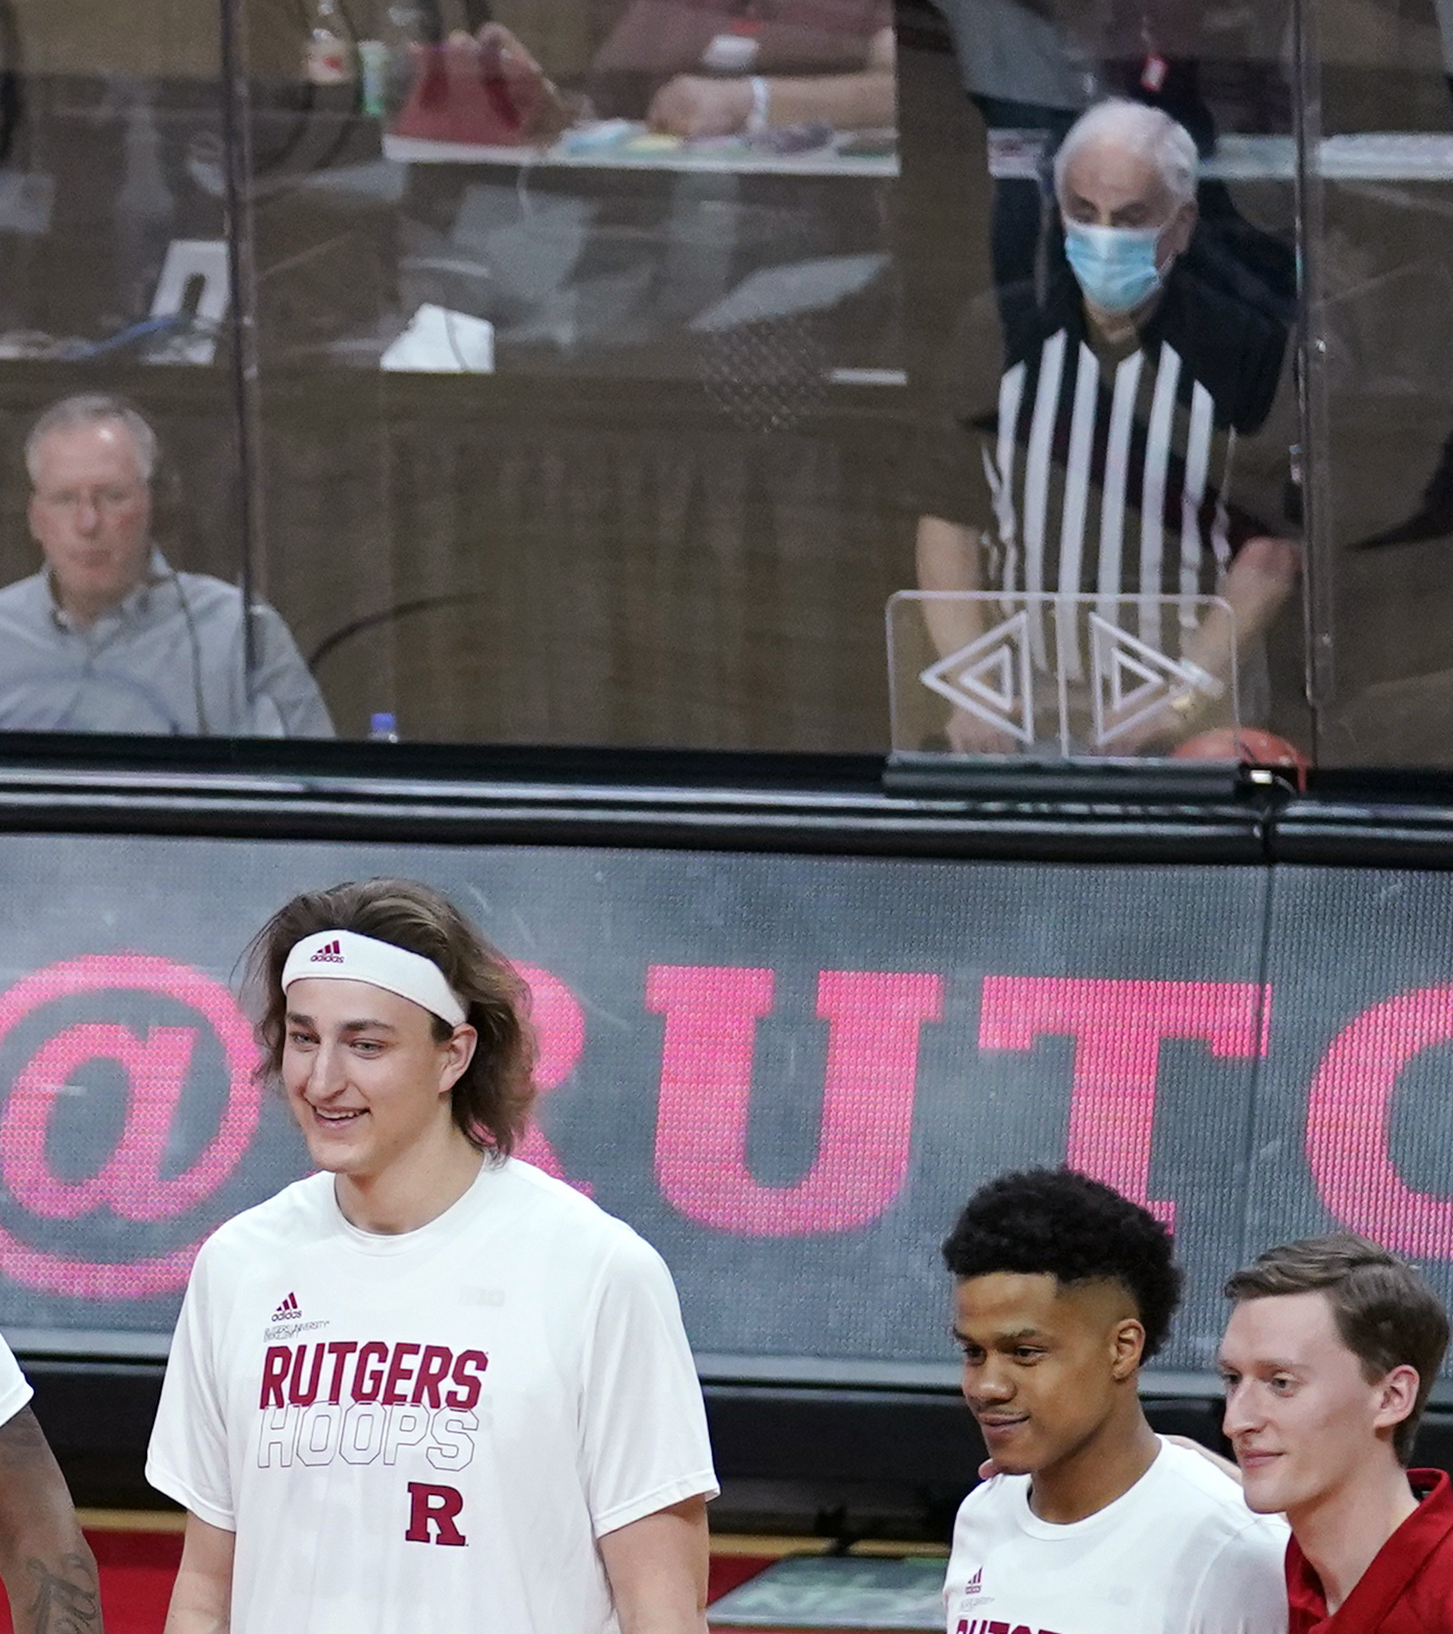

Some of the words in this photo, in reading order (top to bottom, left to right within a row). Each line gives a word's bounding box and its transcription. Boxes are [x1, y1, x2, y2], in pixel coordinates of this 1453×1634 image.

[260, 1341, 488, 1412] RUTGERS
[258, 1400, 479, 1472] HOOPS
[405, 1481, 467, 1547] R
